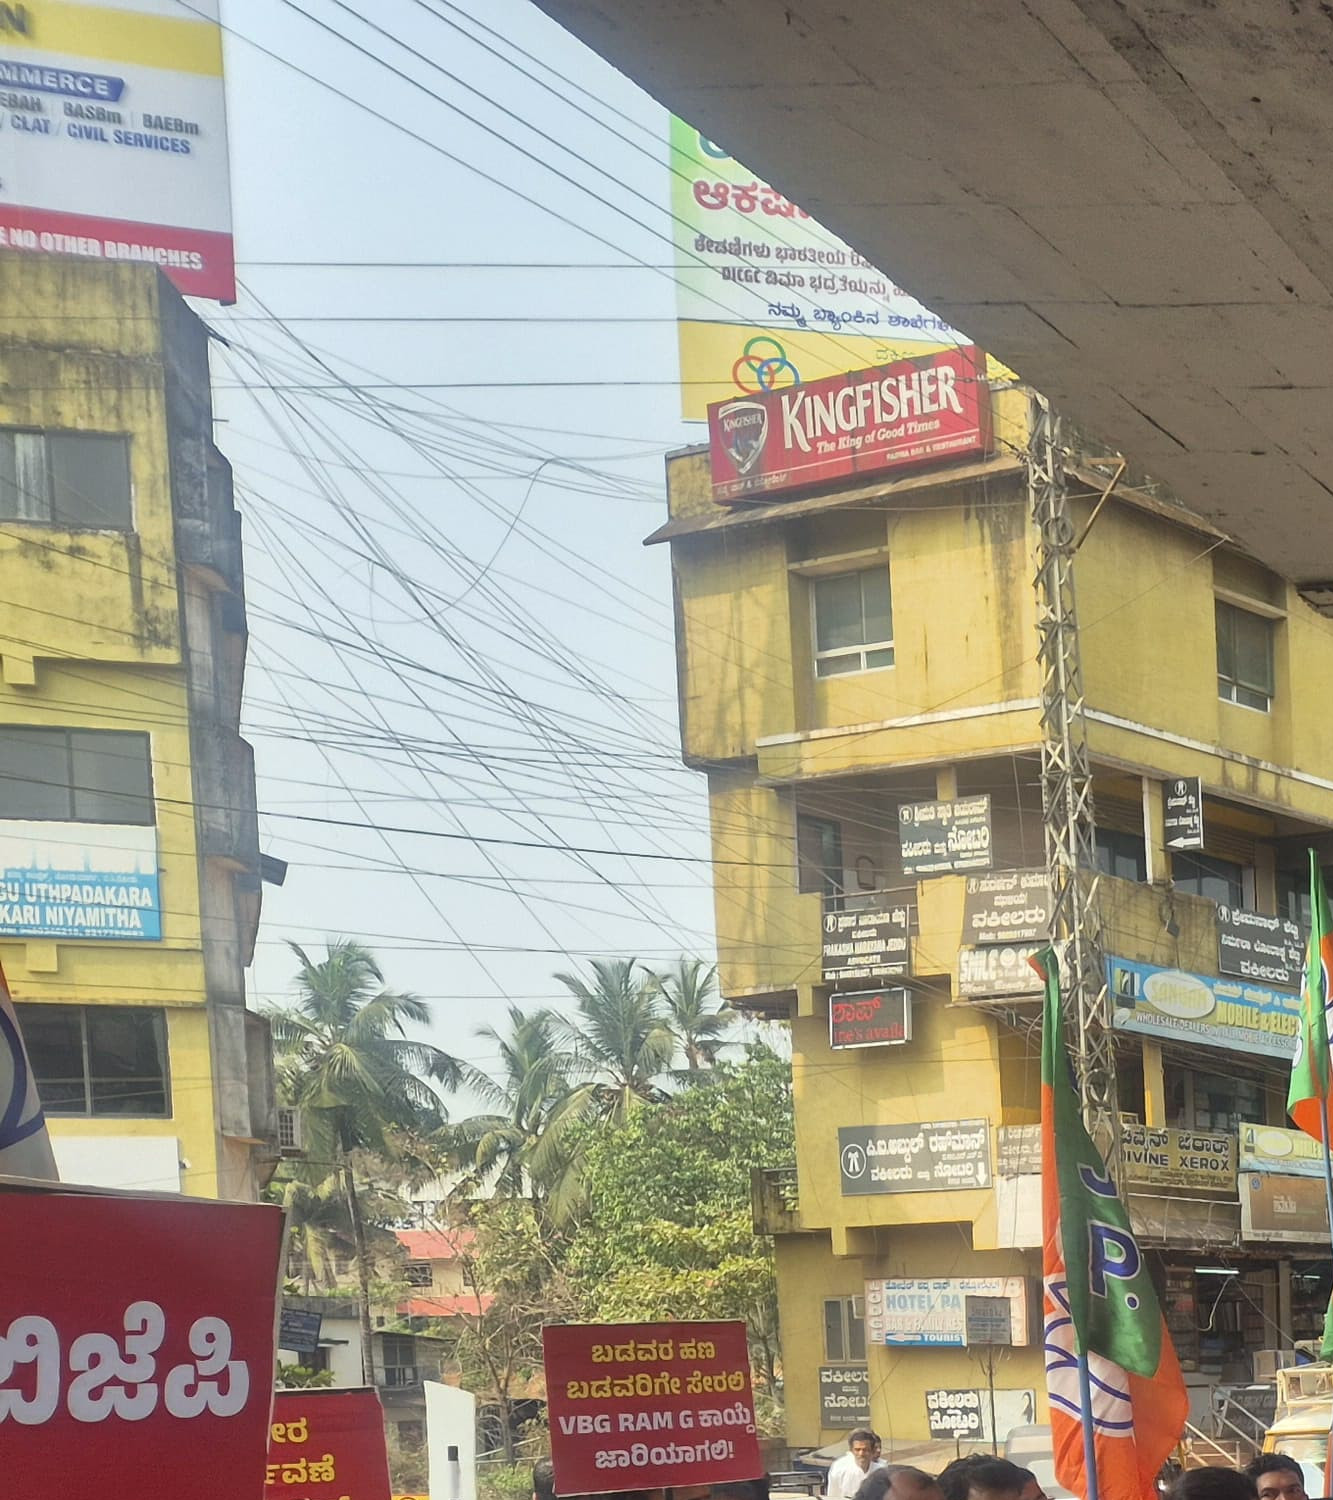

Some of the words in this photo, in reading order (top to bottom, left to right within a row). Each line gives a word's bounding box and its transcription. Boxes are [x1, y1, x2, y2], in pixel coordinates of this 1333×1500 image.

[10, 114, 50, 134] CLAT
[67, 122, 109, 143] CIVIL
[113, 128, 191, 154] SERVICES
[10, 228, 36, 248] NO
[40, 232, 101, 256] OTHER
[104, 240, 203, 270] BRANCHES
[781, 366, 964, 453] KINGFISHER
[723, 413, 763, 433] KINGFISHER
[816, 441, 836, 455] The
[838, 435, 863, 452] King
[865, 432, 876, 445] of
[877, 426, 905, 441] Good
[907, 419, 940, 437] Times
[24, 882, 153, 907] UTHPADAKARA
[46, 907, 142, 929] NIYAMITHA
[972, 905, 1046, 928] ವಕೀಲರು
[1136, 1014, 1178, 1030] WHOLESALE
[1179, 1019, 1210, 1034] DEALERS
[1216, 1000, 1259, 1029] MOBILE
[1180, 1155, 1230, 1171] XEROX
[886, 1294, 936, 1311] HOTEL
[592, 1339, 674, 1364] ಬಡವರ
[680, 1338, 716, 1360] ಹಣ
[686, 1370, 745, 1395] ಸೇರಲಿ
[559, 1414, 612, 1435] VBG
[618, 1411, 674, 1432] RAM
[679, 1410, 694, 1428] G
[595, 1440, 734, 1469] ಜಾರಿಯಾಗಲಿ!
